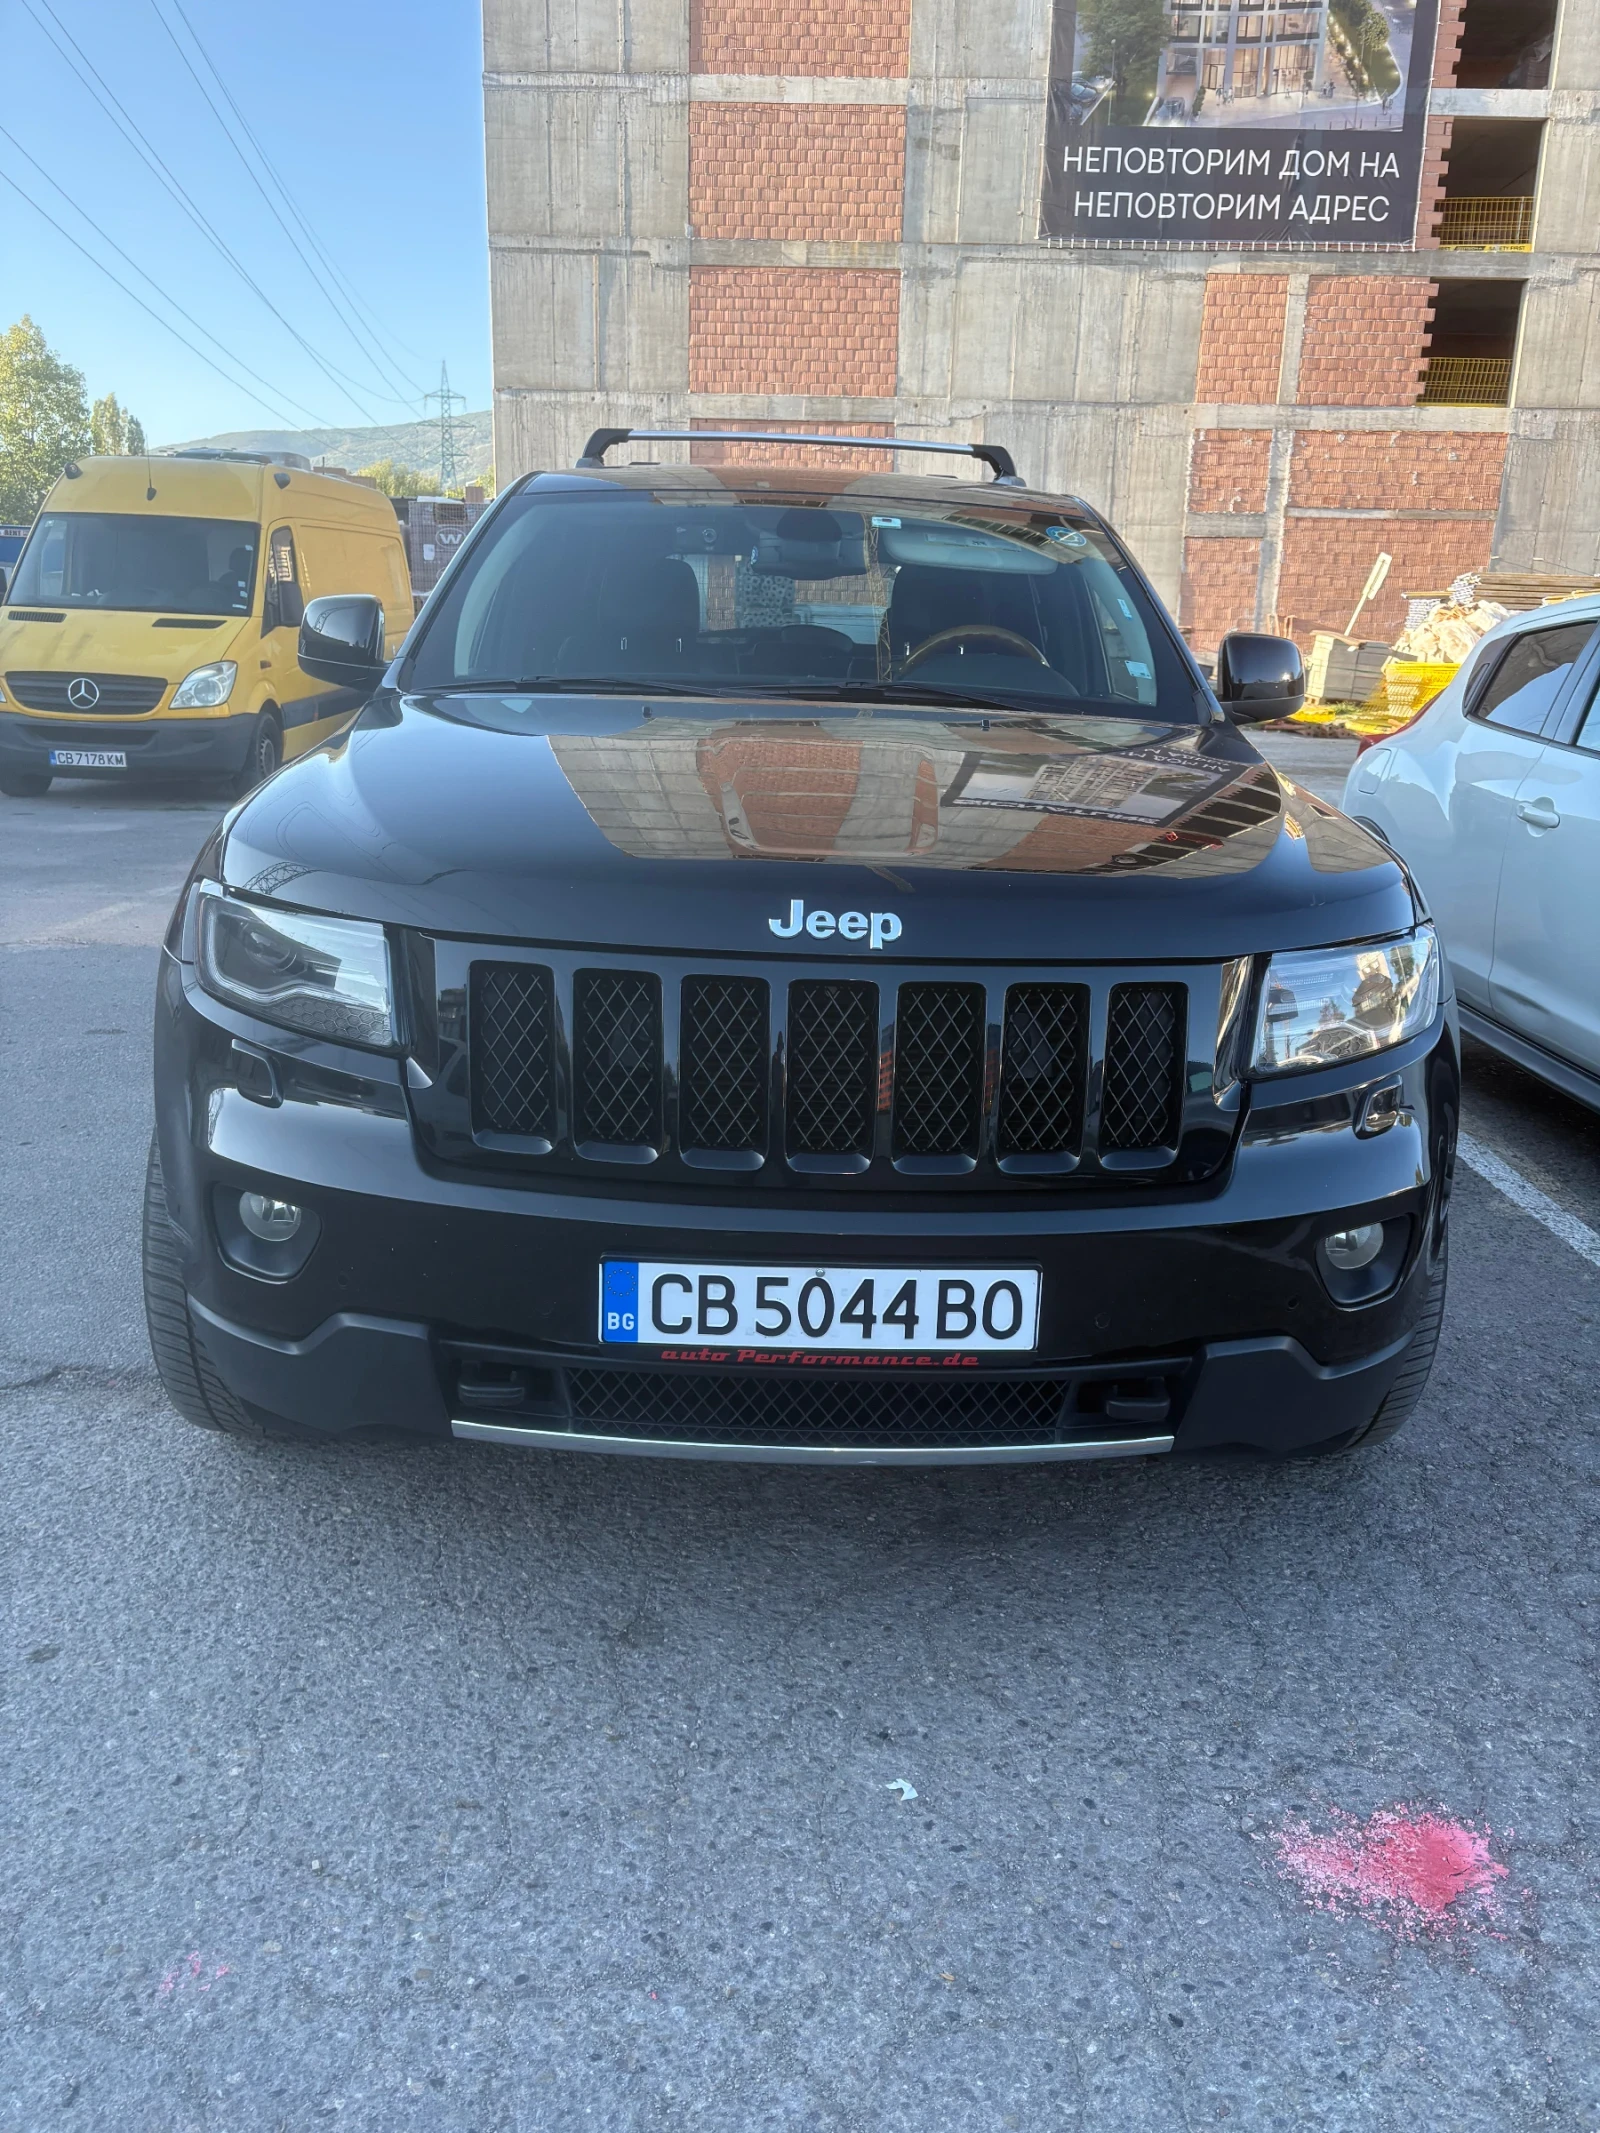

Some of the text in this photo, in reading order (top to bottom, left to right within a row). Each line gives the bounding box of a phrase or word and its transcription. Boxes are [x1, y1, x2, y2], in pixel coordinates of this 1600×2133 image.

[1063, 146, 1400, 180] НЕПОВТОРИМ ДОМ НА
[1074, 191, 1390, 225] НЕПОВТОРИМ АДРЕС
[439, 533, 463, 545] W
[768, 899, 903, 950] Jeep
[607, 1311, 635, 1331] BG
[651, 1273, 739, 1336] CB
[755, 1275, 920, 1340] 5044
[661, 1348, 980, 1366] auto Performance.de
